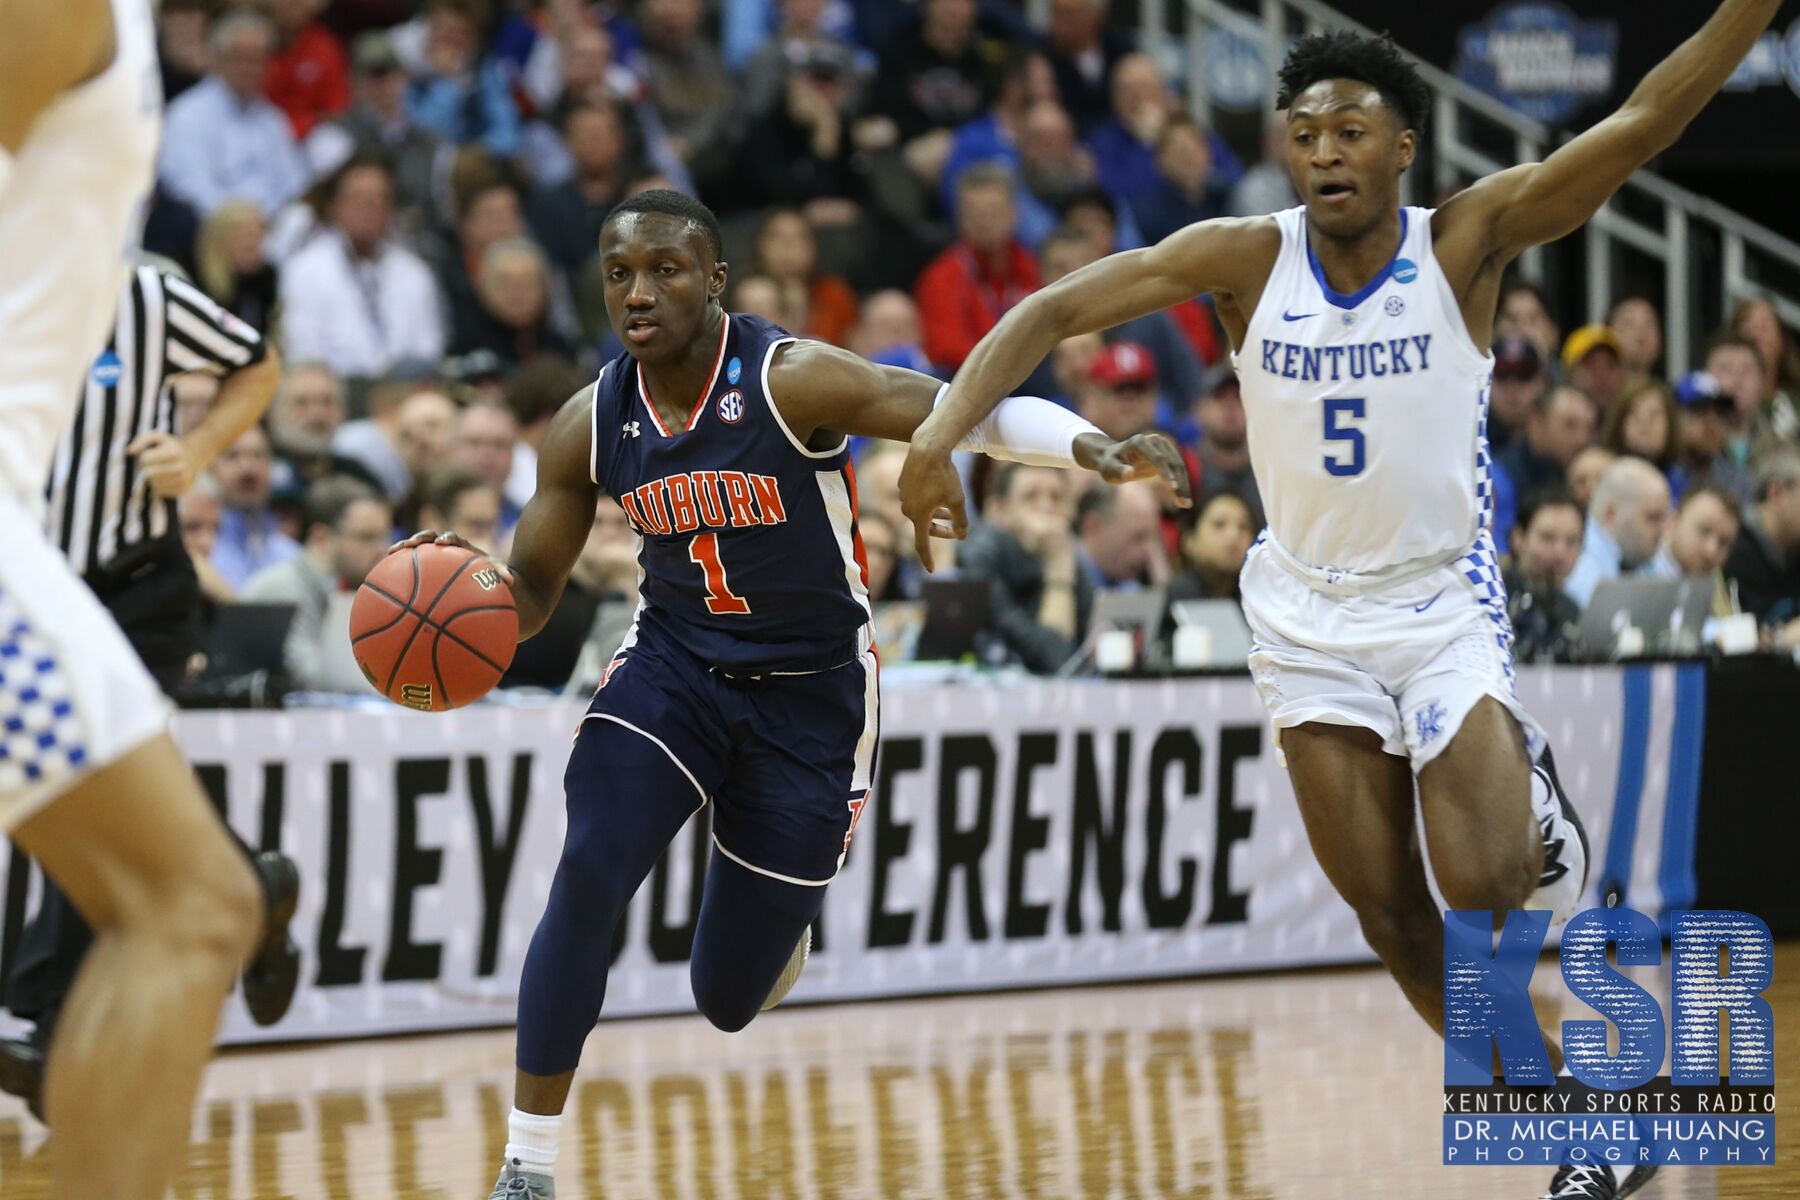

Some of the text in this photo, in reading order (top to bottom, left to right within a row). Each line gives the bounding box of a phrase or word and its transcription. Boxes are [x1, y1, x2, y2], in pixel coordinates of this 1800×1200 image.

[1261, 334, 1432, 382] KENTUCKY
[719, 390, 743, 421] SEC
[1323, 398, 1366, 477] 5
[621, 471, 787, 535] AUBURN
[688, 532, 751, 615] 1
